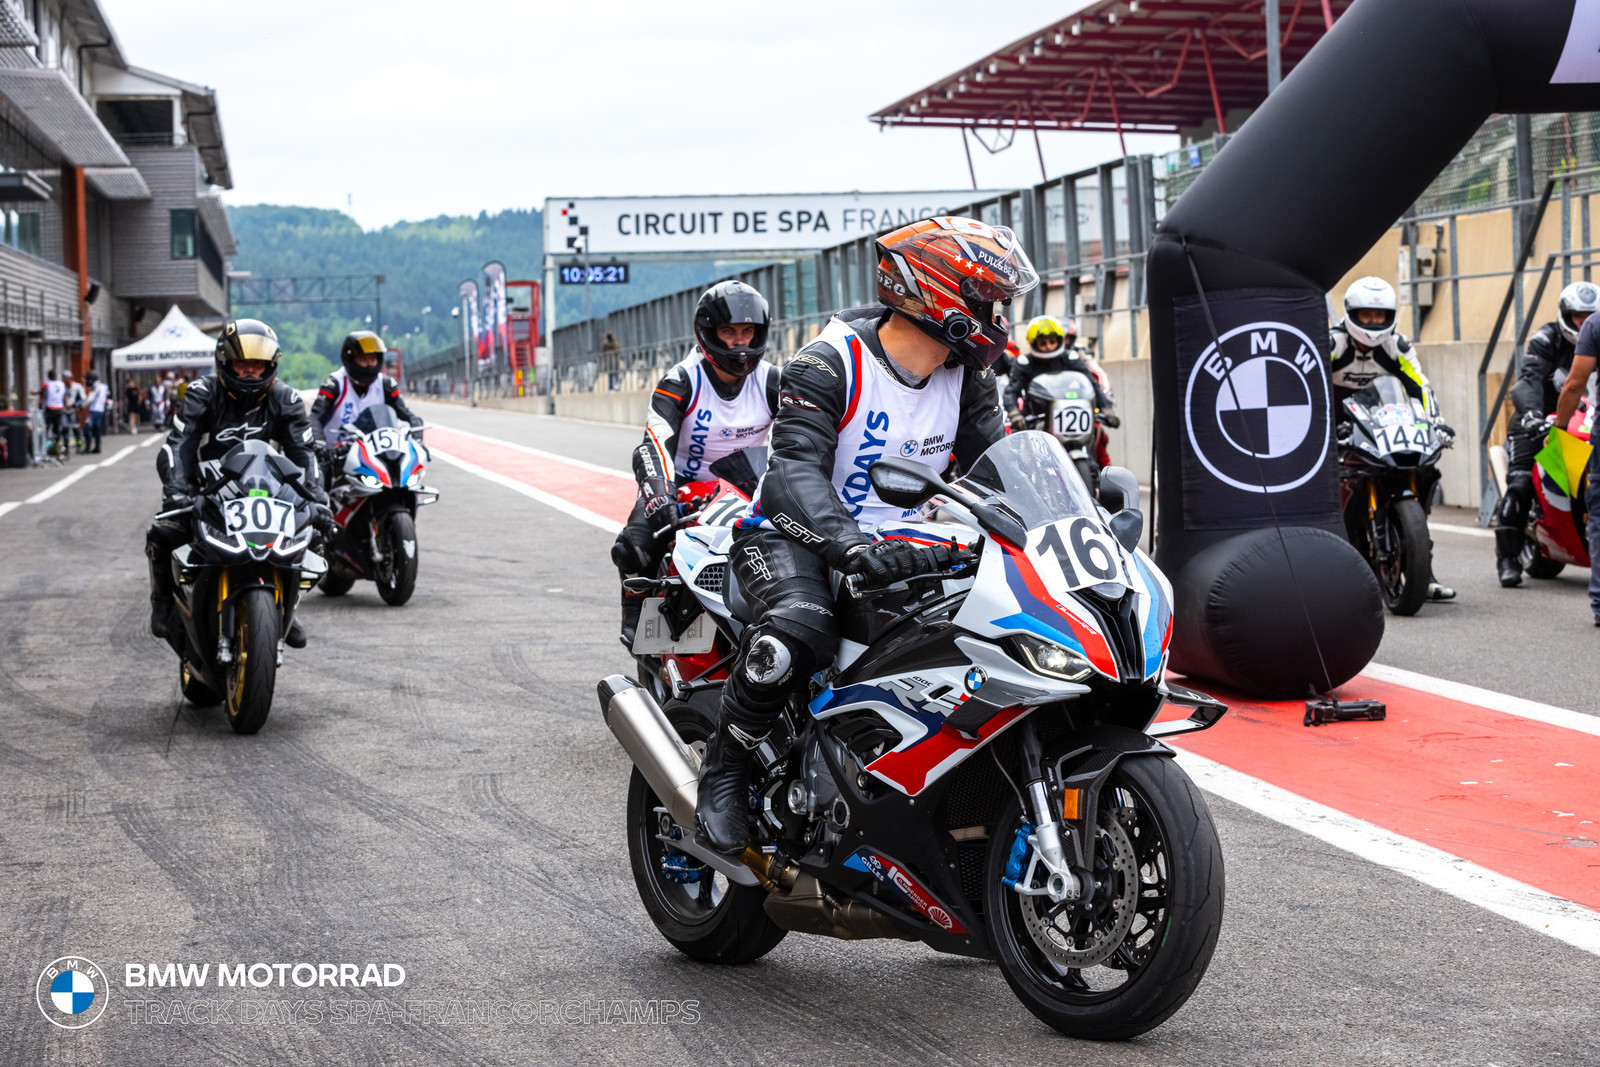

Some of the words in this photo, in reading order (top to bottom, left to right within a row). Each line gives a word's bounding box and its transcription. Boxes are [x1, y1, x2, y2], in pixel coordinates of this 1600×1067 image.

[617, 212, 723, 236] CIRCUIT
[733, 211, 768, 234] DE
[778, 210, 830, 232] SPA
[842, 206, 948, 231] FRANC
[1203, 331, 1318, 382] BMW
[1054, 410, 1091, 434] 120
[922, 434, 945, 447] BMW
[1376, 425, 1430, 453] 144
[226, 498, 293, 534] 307
[772, 512, 825, 544] RST
[1035, 517, 1133, 589] 16
[861, 856, 885, 882] GILLES
